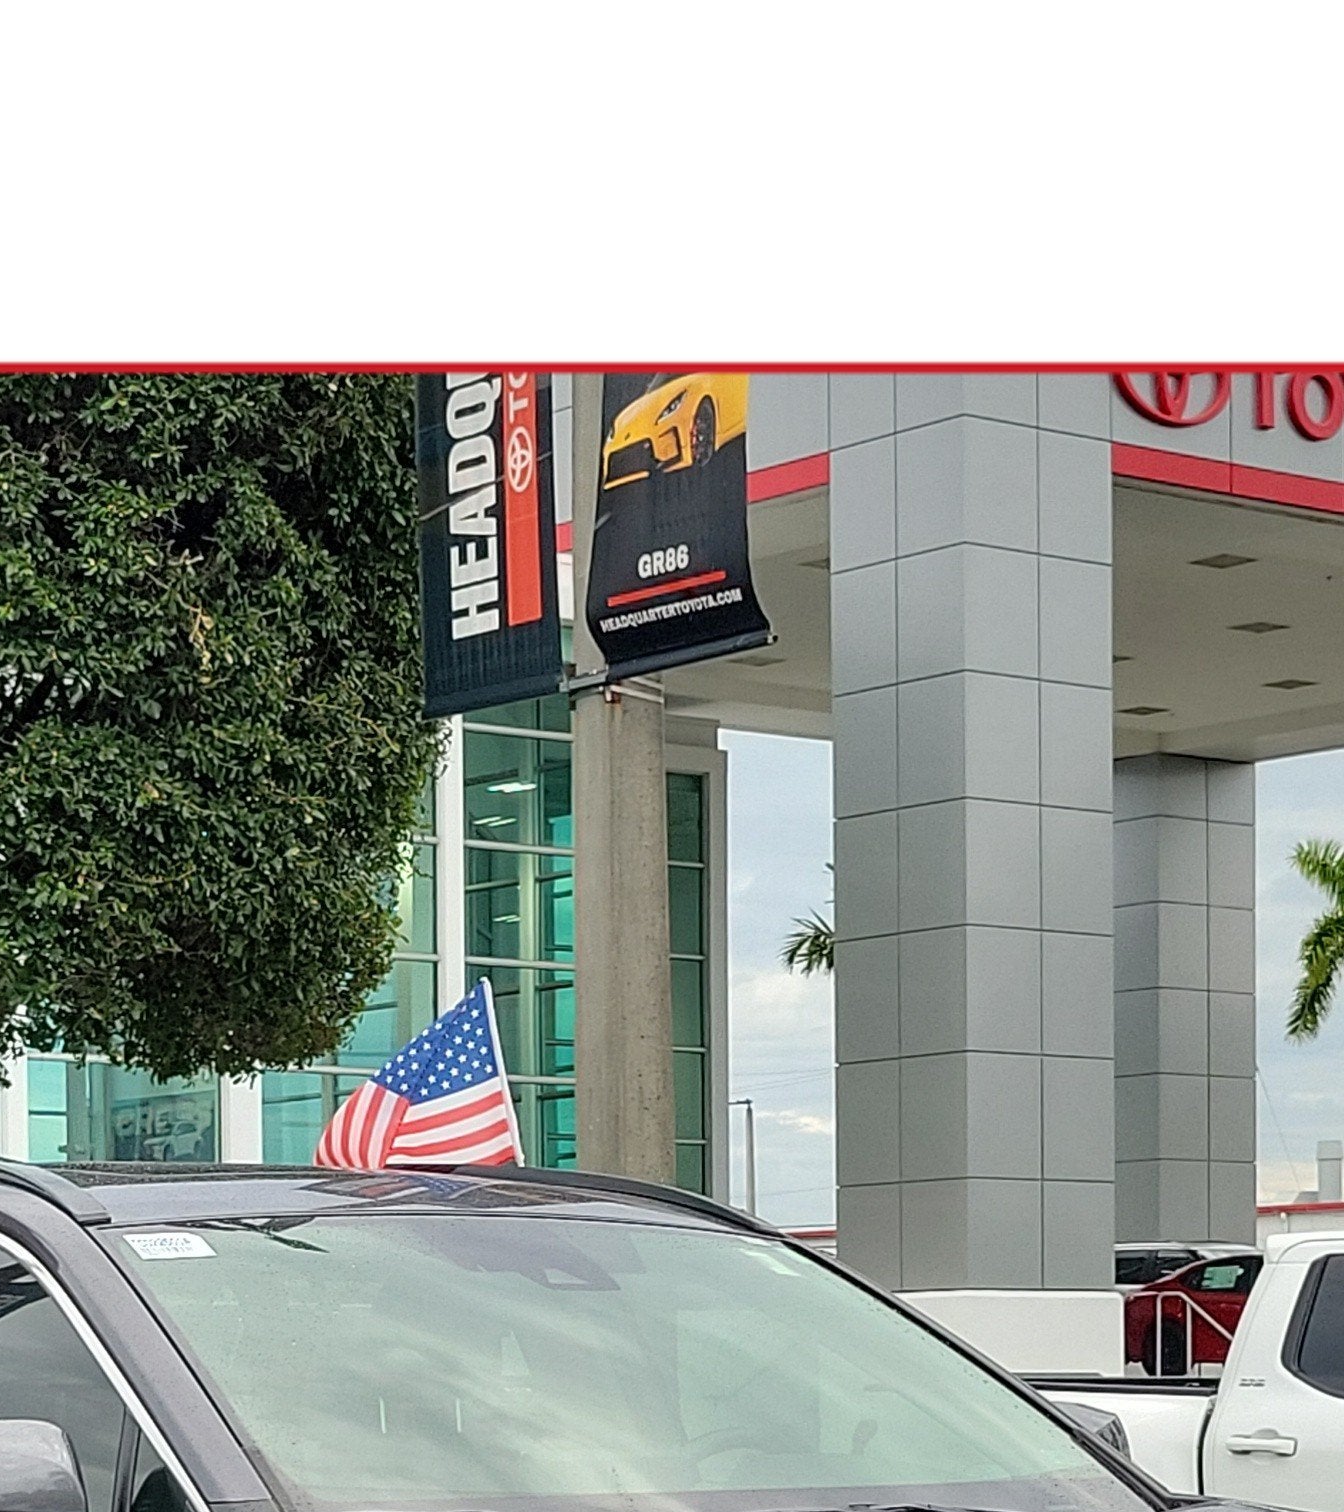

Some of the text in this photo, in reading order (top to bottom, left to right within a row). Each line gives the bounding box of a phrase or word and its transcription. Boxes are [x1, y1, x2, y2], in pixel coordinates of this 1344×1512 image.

[445, 373, 502, 641] HEADQ
[637, 543, 690, 580] GR86
[599, 587, 743, 633] HEADQUARTERTOYOTA.COM
